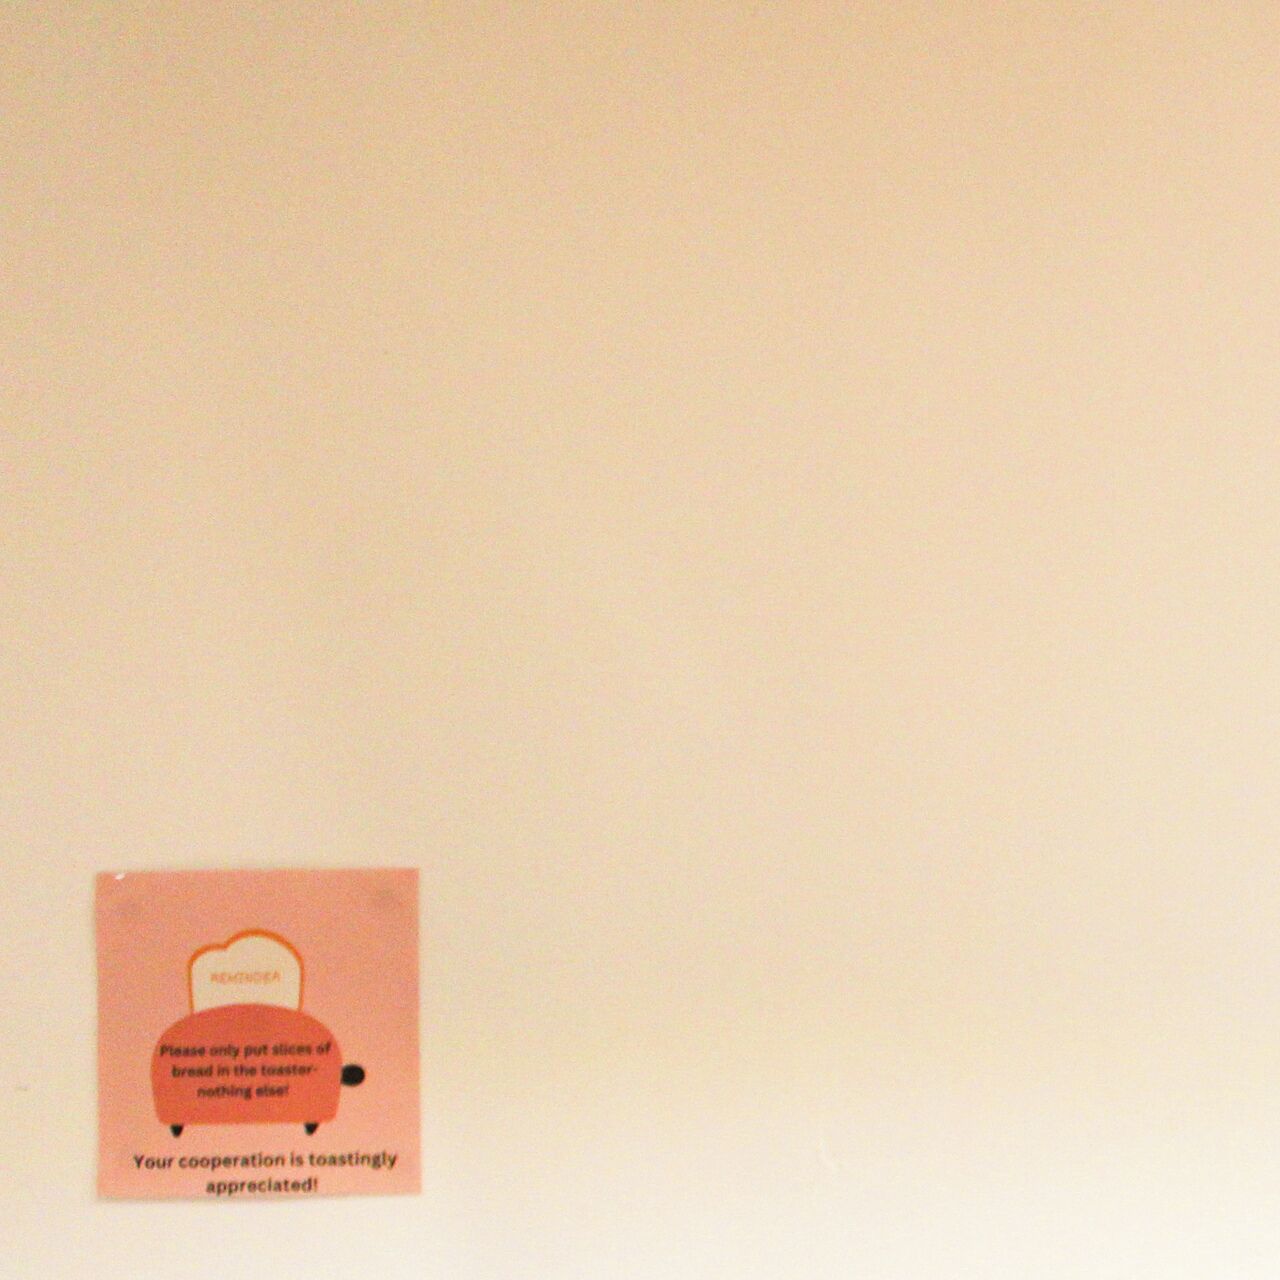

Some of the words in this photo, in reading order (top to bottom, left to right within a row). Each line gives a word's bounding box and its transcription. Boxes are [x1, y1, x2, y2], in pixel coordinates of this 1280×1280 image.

[159, 1044, 206, 1057] Please
[209, 1044, 239, 1059] only
[243, 1044, 269, 1059] put
[272, 1043, 312, 1056] slices
[315, 1041, 332, 1055] of
[171, 1063, 213, 1078] bread
[217, 1063, 230, 1077] in
[233, 1063, 257, 1077] the
[197, 1085, 252, 1100] nothing
[255, 1084, 290, 1098] else!
[134, 1154, 175, 1170] Your
[178, 1153, 286, 1171] cooperation
[289, 1152, 305, 1168] is
[308, 1151, 398, 1170] toastingly
[205, 1178, 319, 1196] appreciated!
